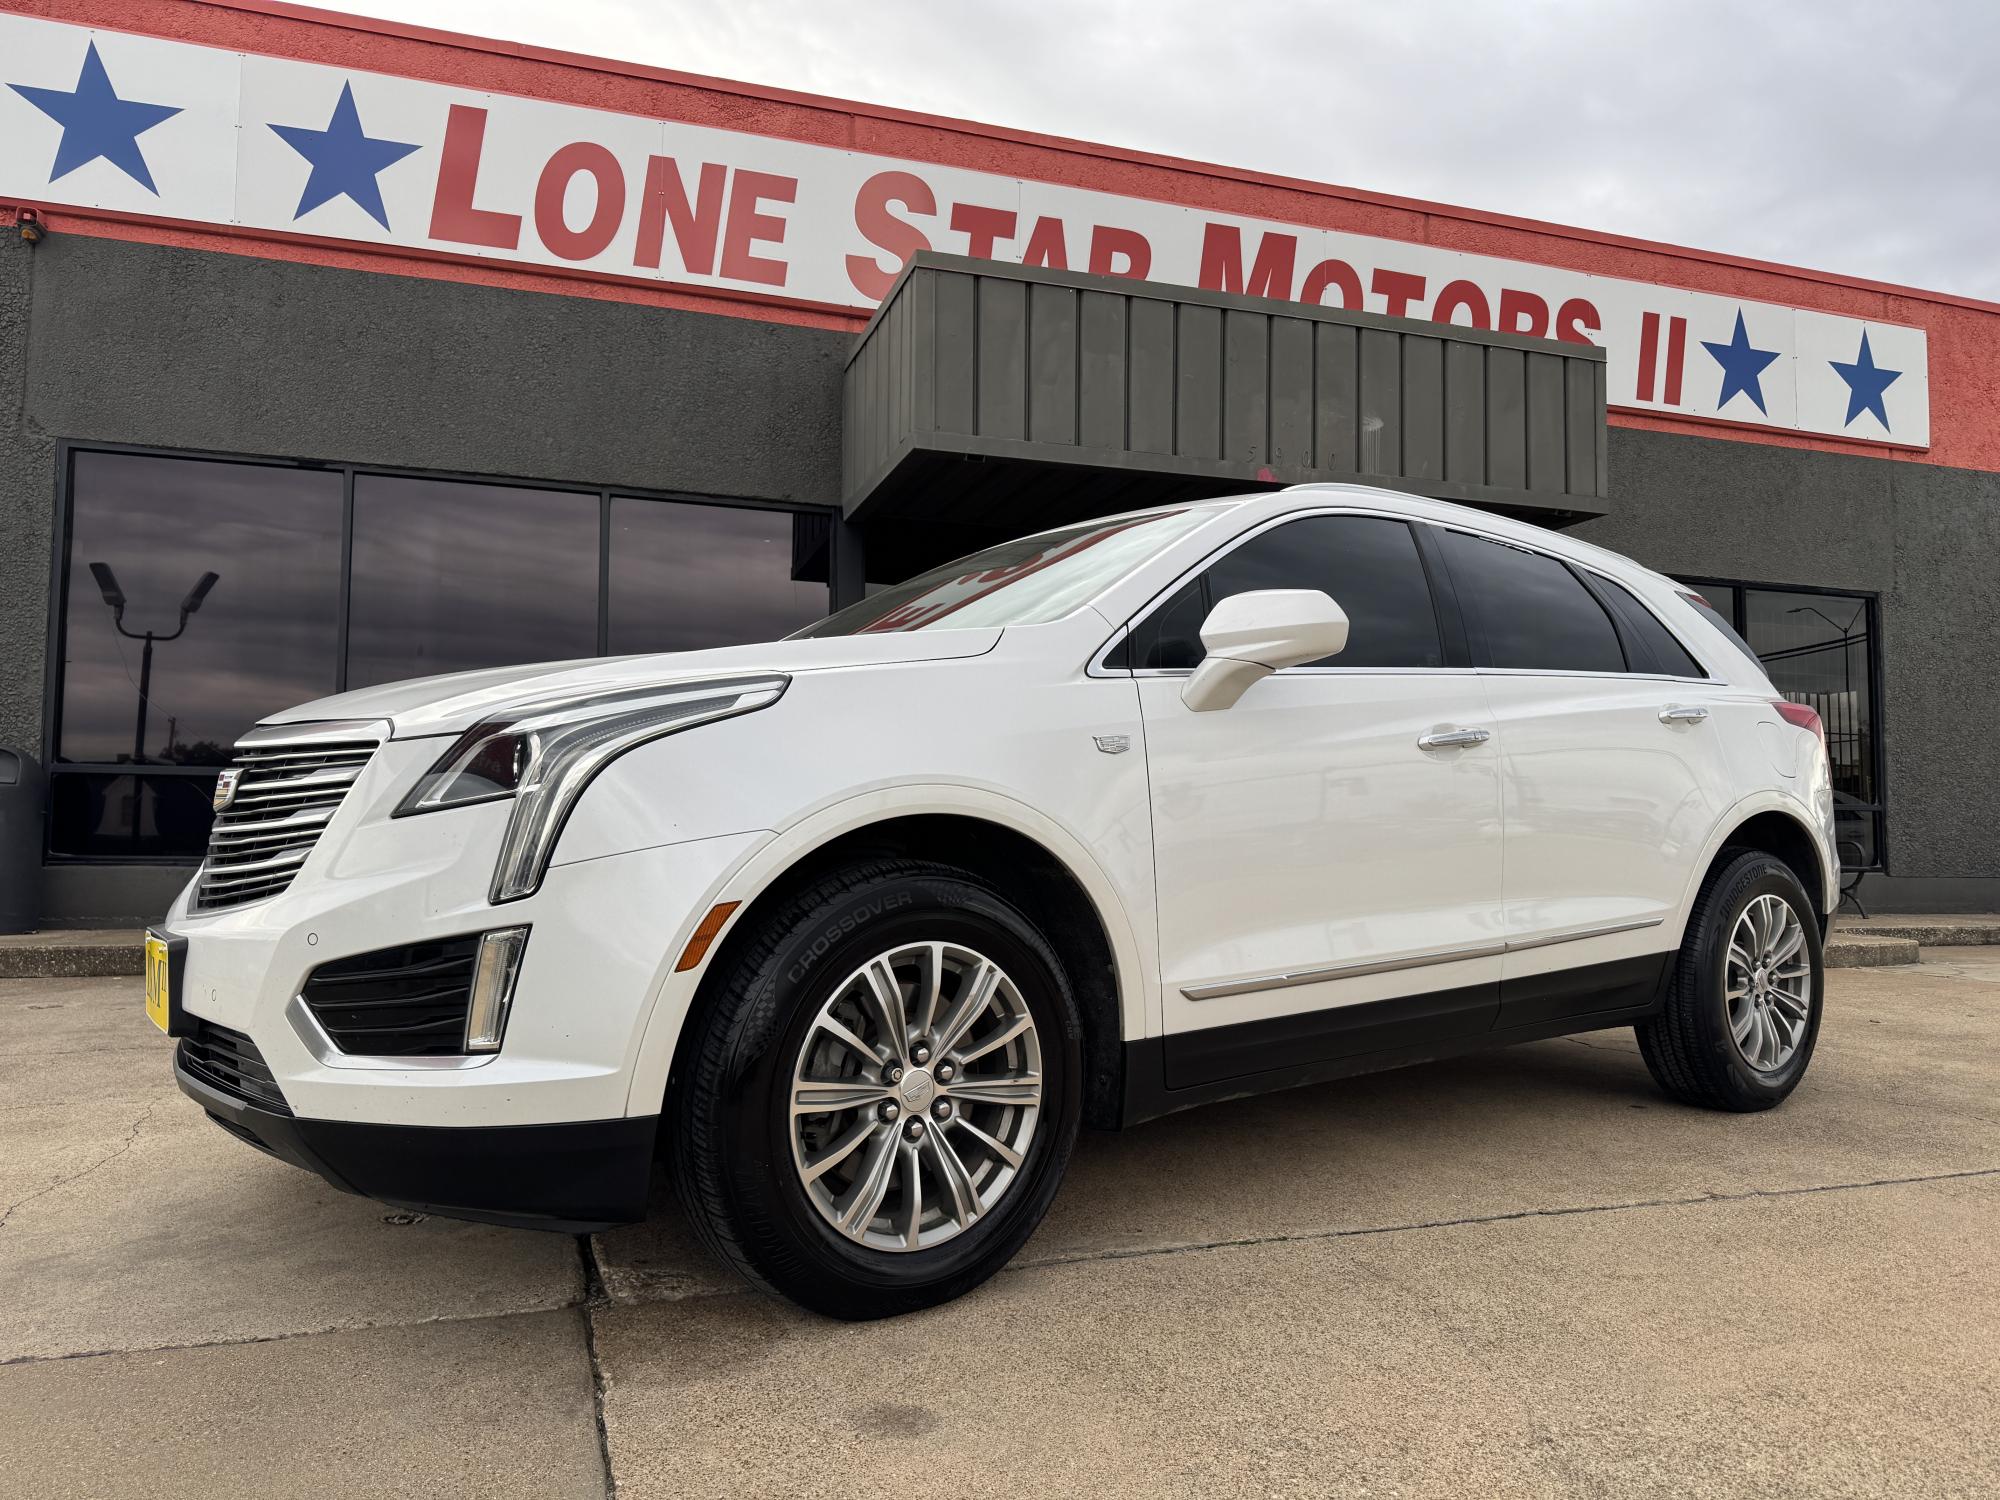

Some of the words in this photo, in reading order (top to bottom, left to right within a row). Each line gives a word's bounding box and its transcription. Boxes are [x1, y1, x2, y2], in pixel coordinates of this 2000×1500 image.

[428, 104, 798, 287] LONE
[1636, 312, 1687, 405] II
[788, 892, 912, 983] CROSSOVER
